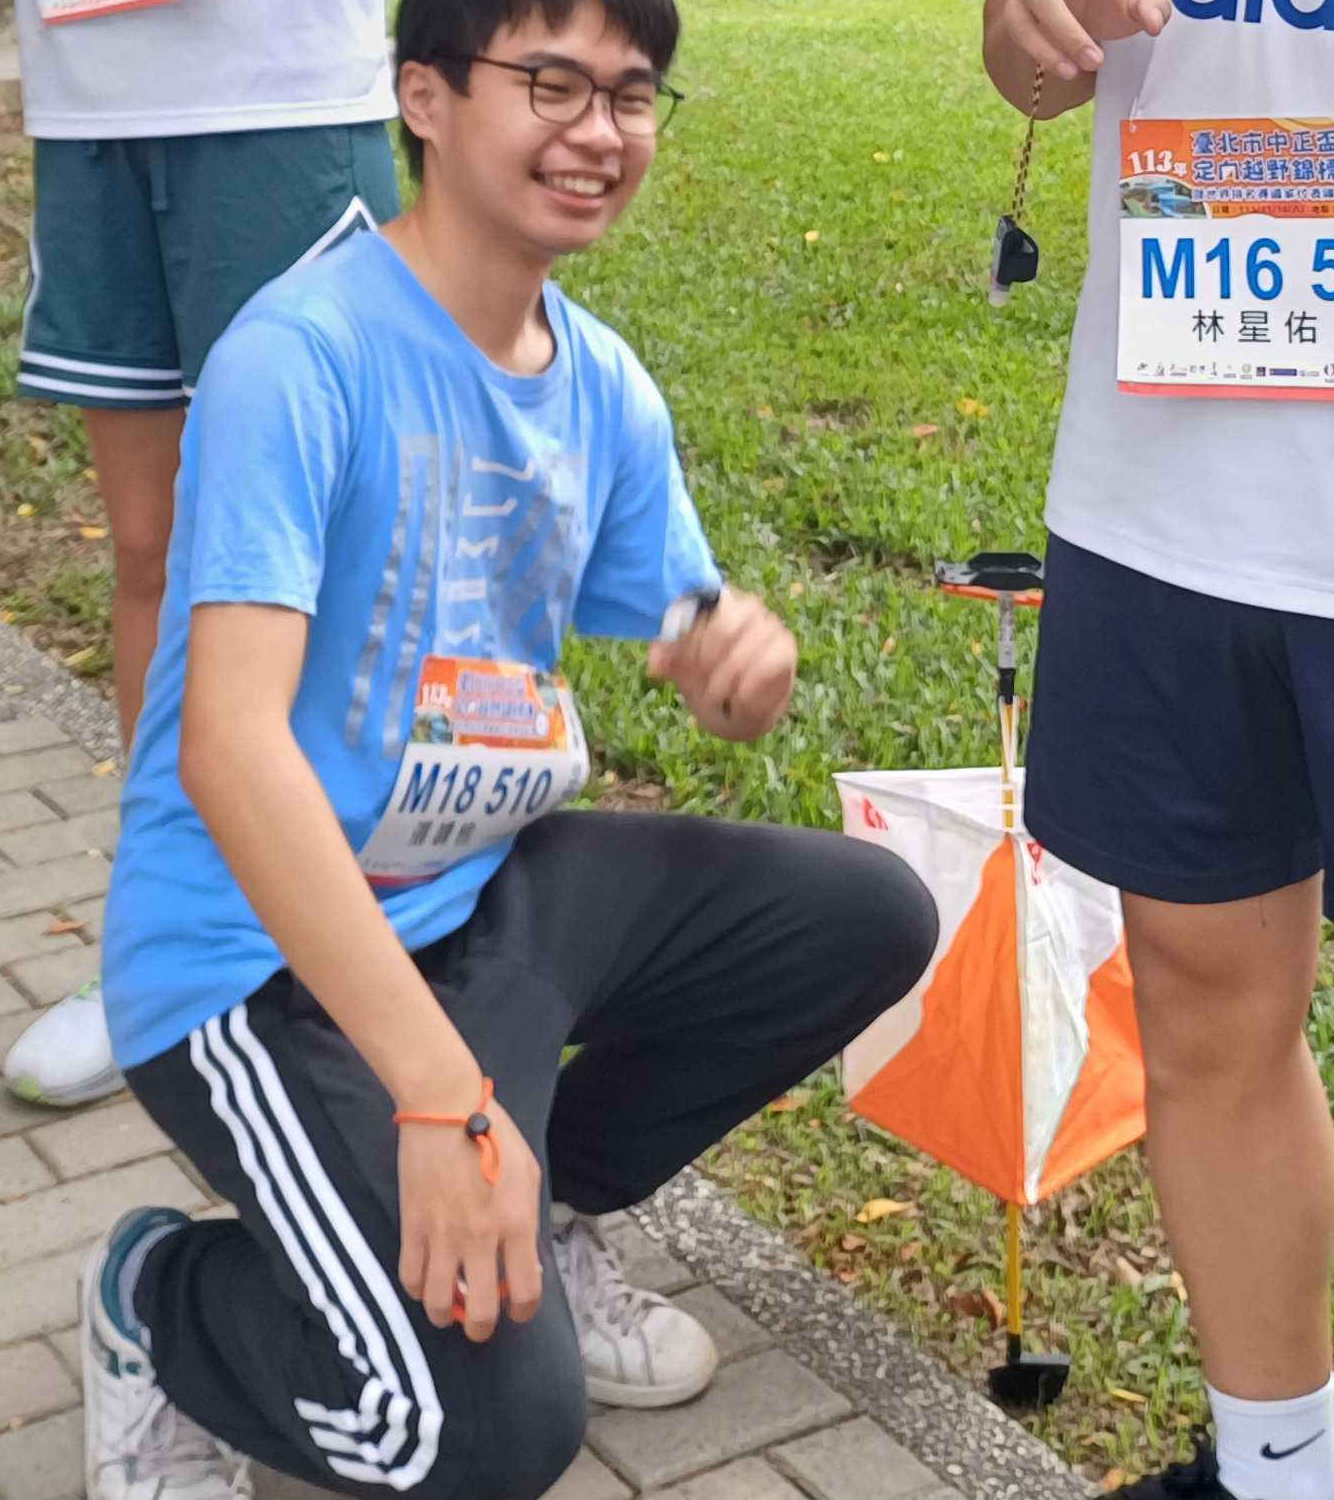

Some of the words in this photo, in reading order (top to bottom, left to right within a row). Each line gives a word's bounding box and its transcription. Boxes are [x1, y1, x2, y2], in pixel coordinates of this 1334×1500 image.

[1127, 147, 1187, 177] 113年
[1140, 237, 1283, 301] M16
[1192, 309, 1319, 345] 林星佑
[398, 762, 483, 815] M18
[484, 767, 553, 815] 510
